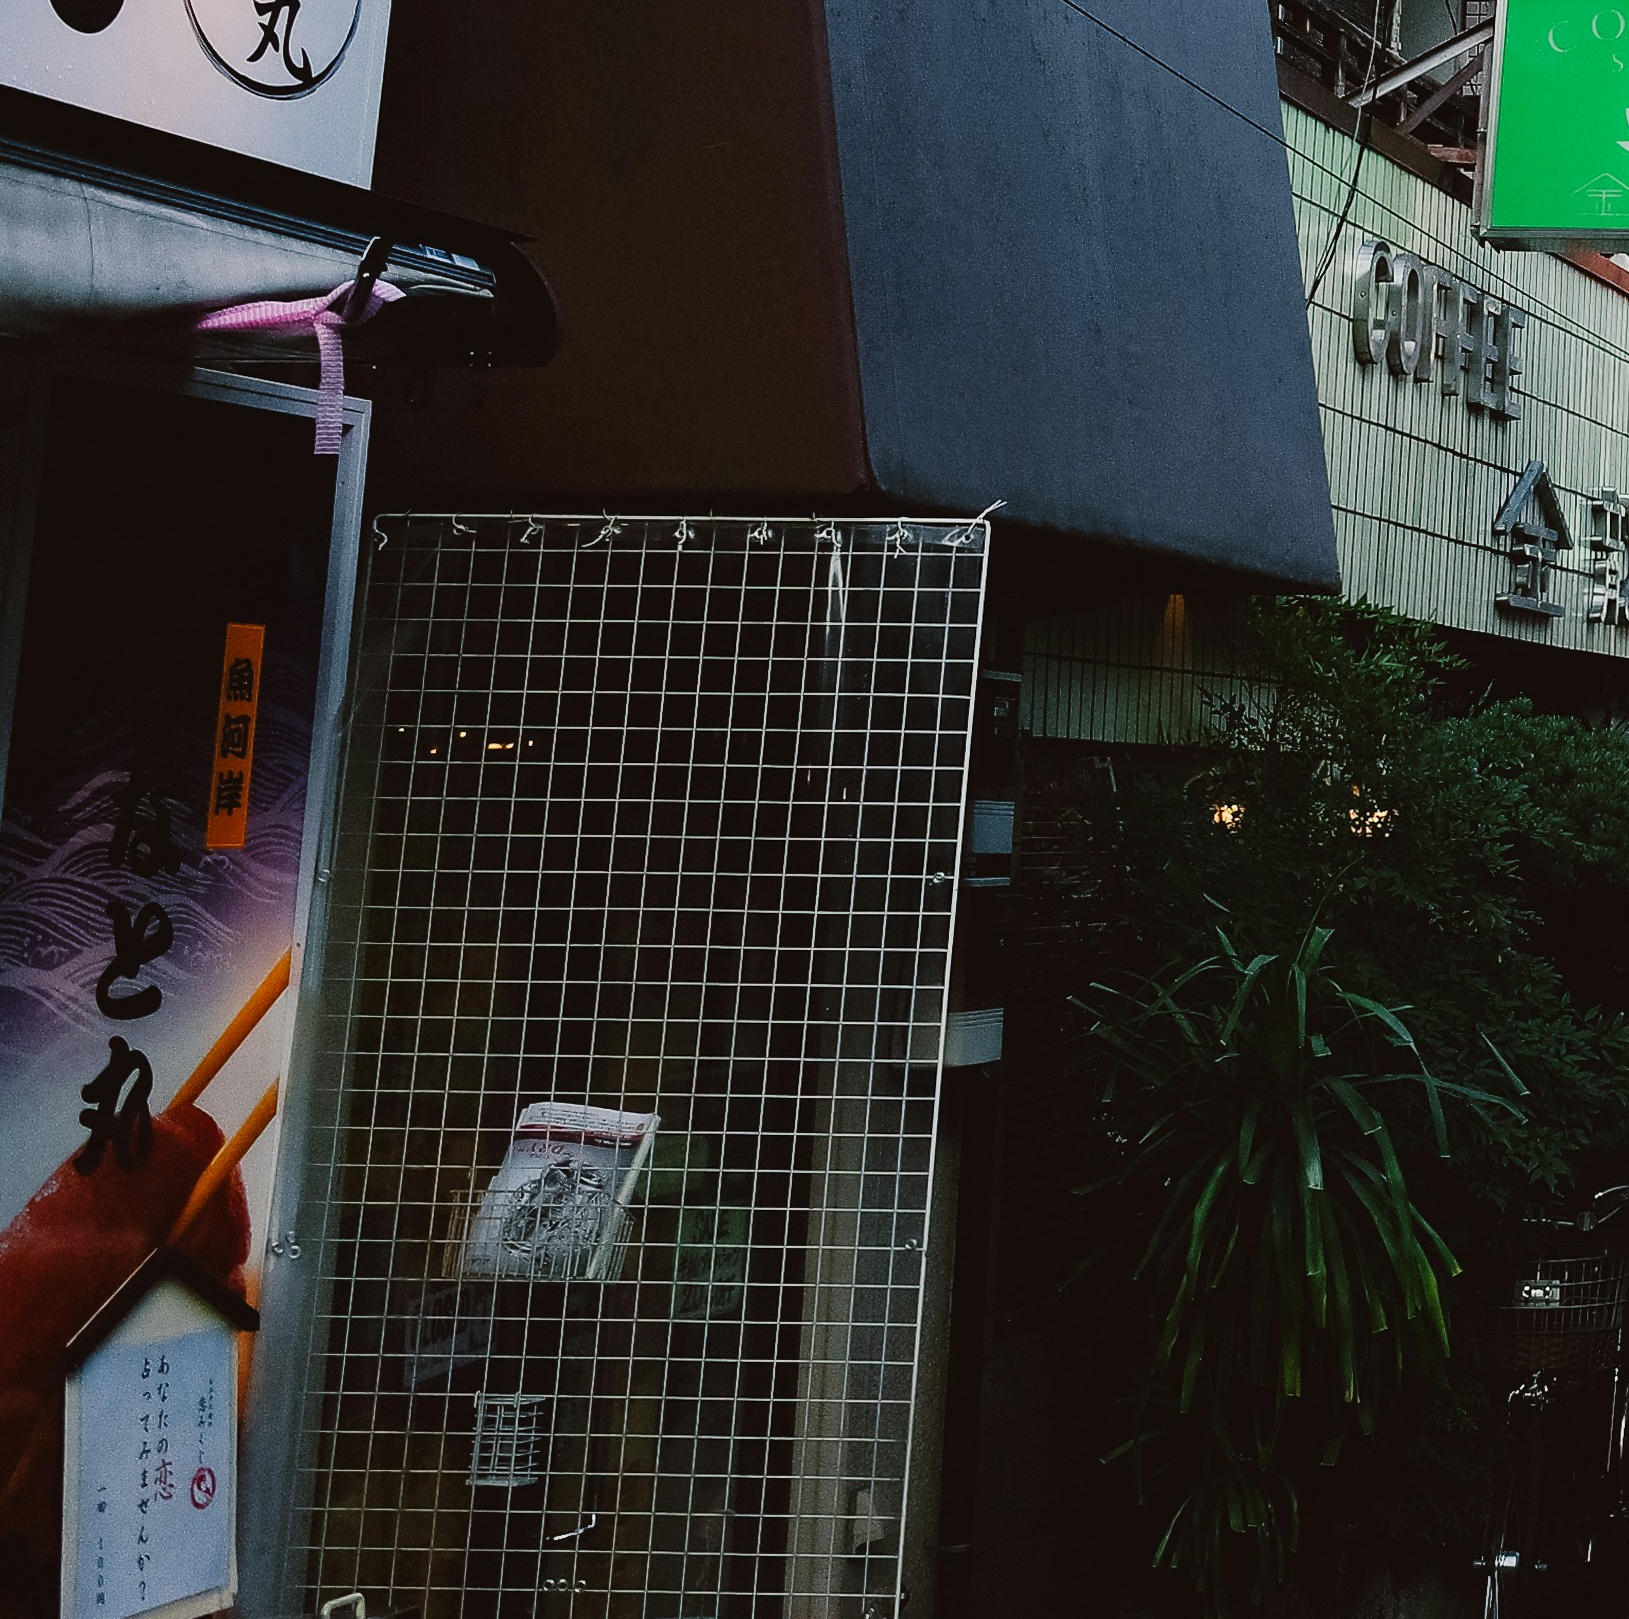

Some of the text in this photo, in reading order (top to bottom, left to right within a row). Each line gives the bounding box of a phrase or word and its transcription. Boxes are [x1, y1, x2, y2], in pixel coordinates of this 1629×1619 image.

[1353, 239, 1526, 422] COFFEE
[214, 656, 254, 817] 魚河岸
